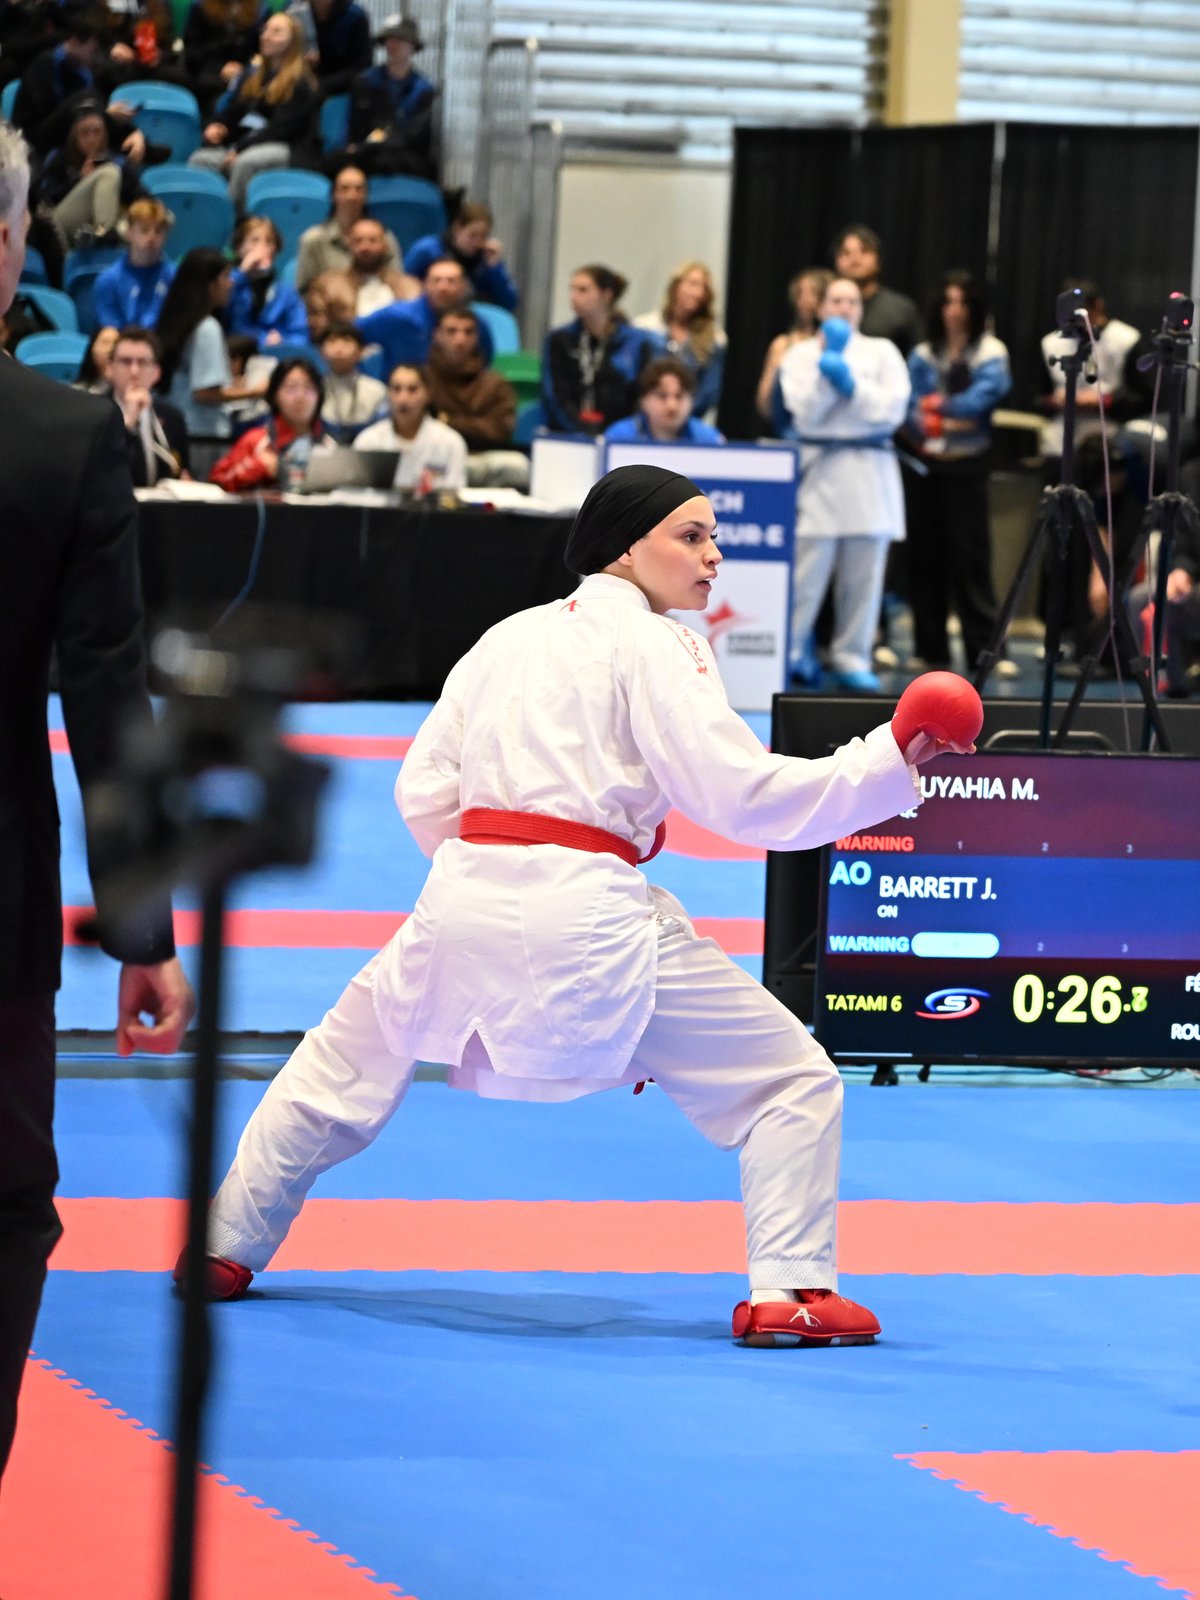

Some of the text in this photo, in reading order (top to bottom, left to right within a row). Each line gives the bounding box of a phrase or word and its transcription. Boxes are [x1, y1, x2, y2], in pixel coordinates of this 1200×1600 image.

[920, 776, 1039, 800] UYAHIA M.
[835, 835, 914, 851] WARNING
[1042, 842, 1048, 851] 2
[1126, 844, 1133, 853] 3
[829, 861, 872, 885] AO
[880, 875, 997, 900] BARRETT J.
[877, 905, 898, 918] ON
[829, 935, 910, 953] WARNING
[1037, 943, 1044, 952] 2
[1122, 944, 1128, 953] 3
[825, 994, 902, 1012] TATAMI 6
